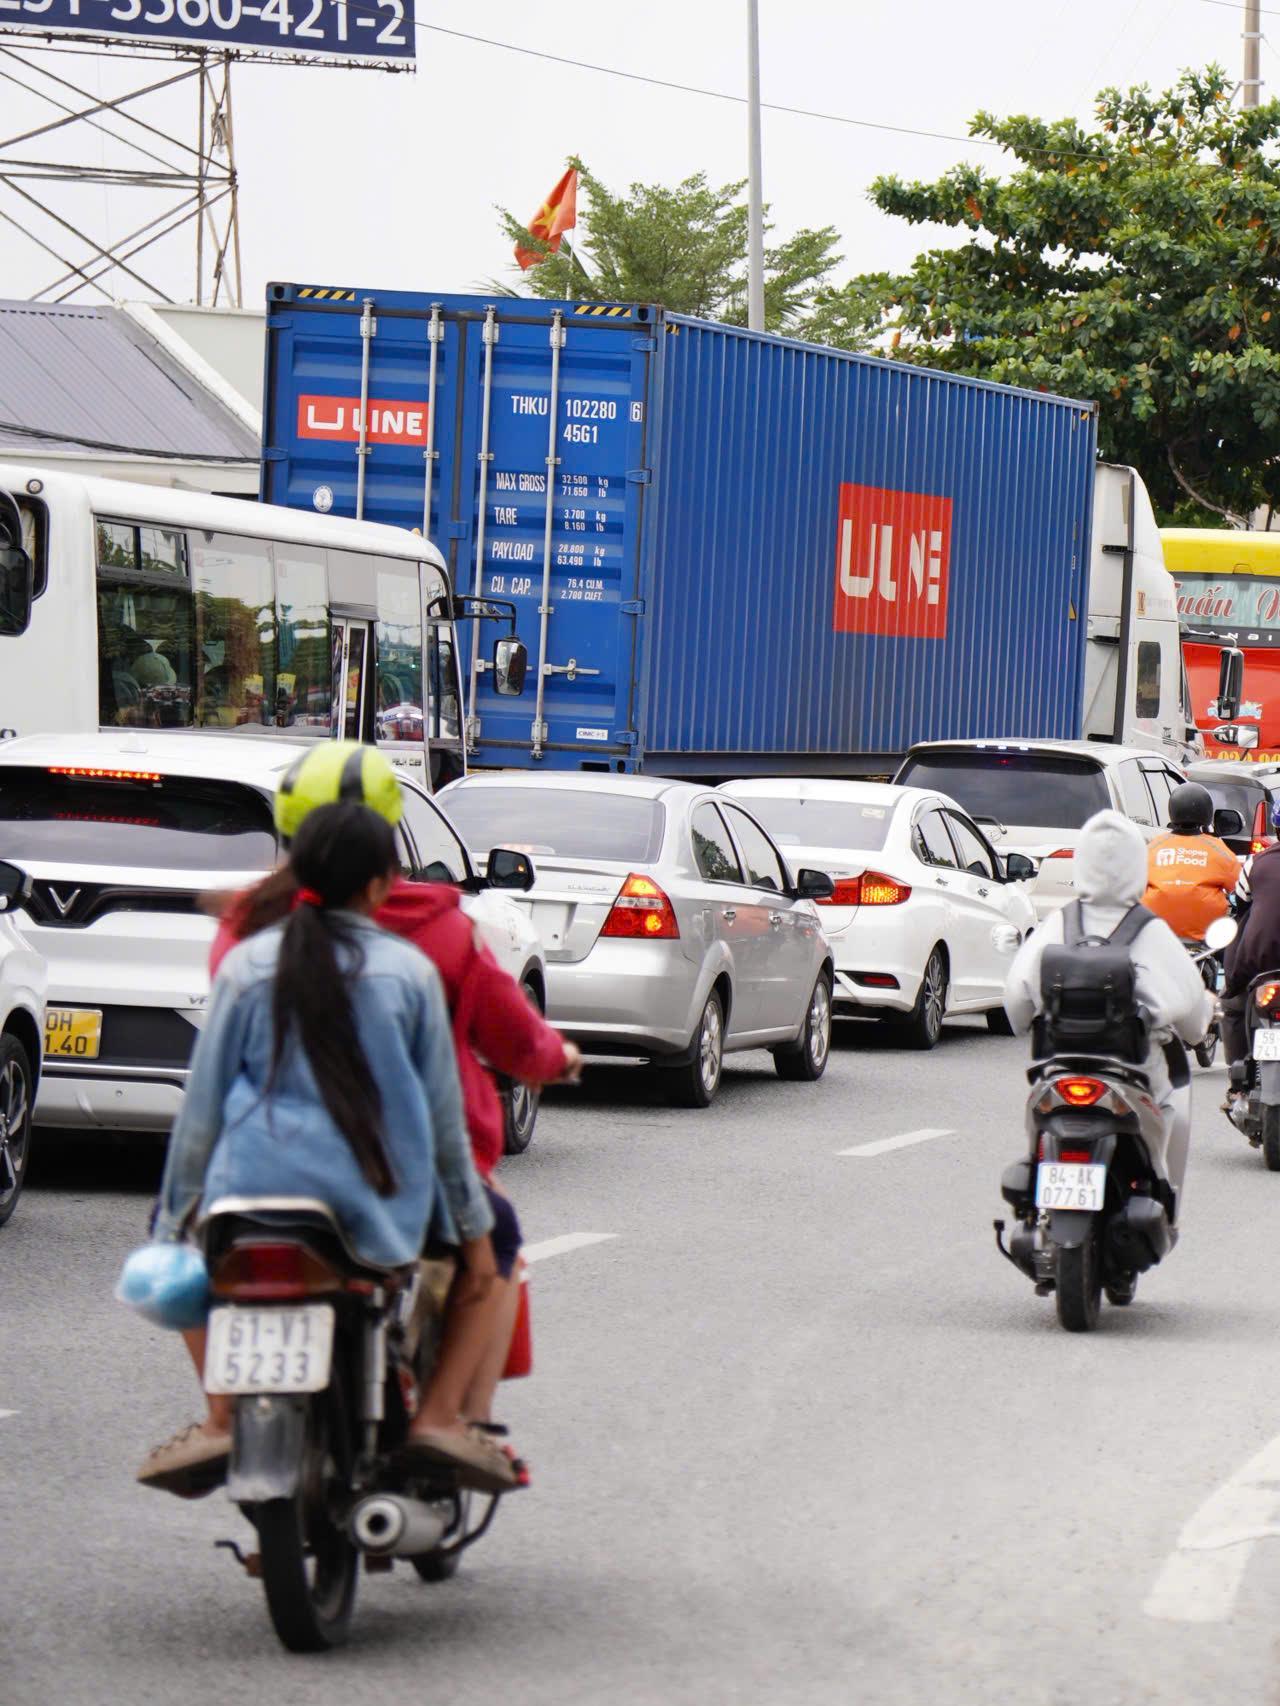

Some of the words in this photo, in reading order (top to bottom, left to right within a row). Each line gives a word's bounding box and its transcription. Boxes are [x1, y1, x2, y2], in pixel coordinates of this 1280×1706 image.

[511, 395, 548, 415] THKU
[565, 399, 617, 419] 102280
[632, 403, 641, 421] 6
[563, 424, 598, 443] 45G1
[496, 472, 516, 491] MAX
[519, 474, 545, 492] GROSS
[562, 475, 588, 485] 32.500
[598, 476, 609, 488] kg
[562, 486, 588, 497] 71.650
[598, 488, 606, 498] lb
[494, 506, 518, 525] TARE
[564, 509, 585, 520] 3.700
[595, 511, 607, 523] kg
[596, 522, 604, 532] lb
[492, 541, 534, 561] PAYLOAD
[594, 545, 605, 556] kg
[593, 557, 602, 567] lb
[491, 575, 505, 593] CU.
[511, 577, 531, 595] CAP.
[567, 578, 584, 588] 76.4
[561, 590, 582, 600] 2.700
[1176, 855, 1207, 867] Food
[1177, 847, 1208, 857] Shopee
[1050, 1167, 1095, 1185] 84-AK
[229, 1314, 312, 1347] 61-V1
[225, 1352, 310, 1385] 5233
